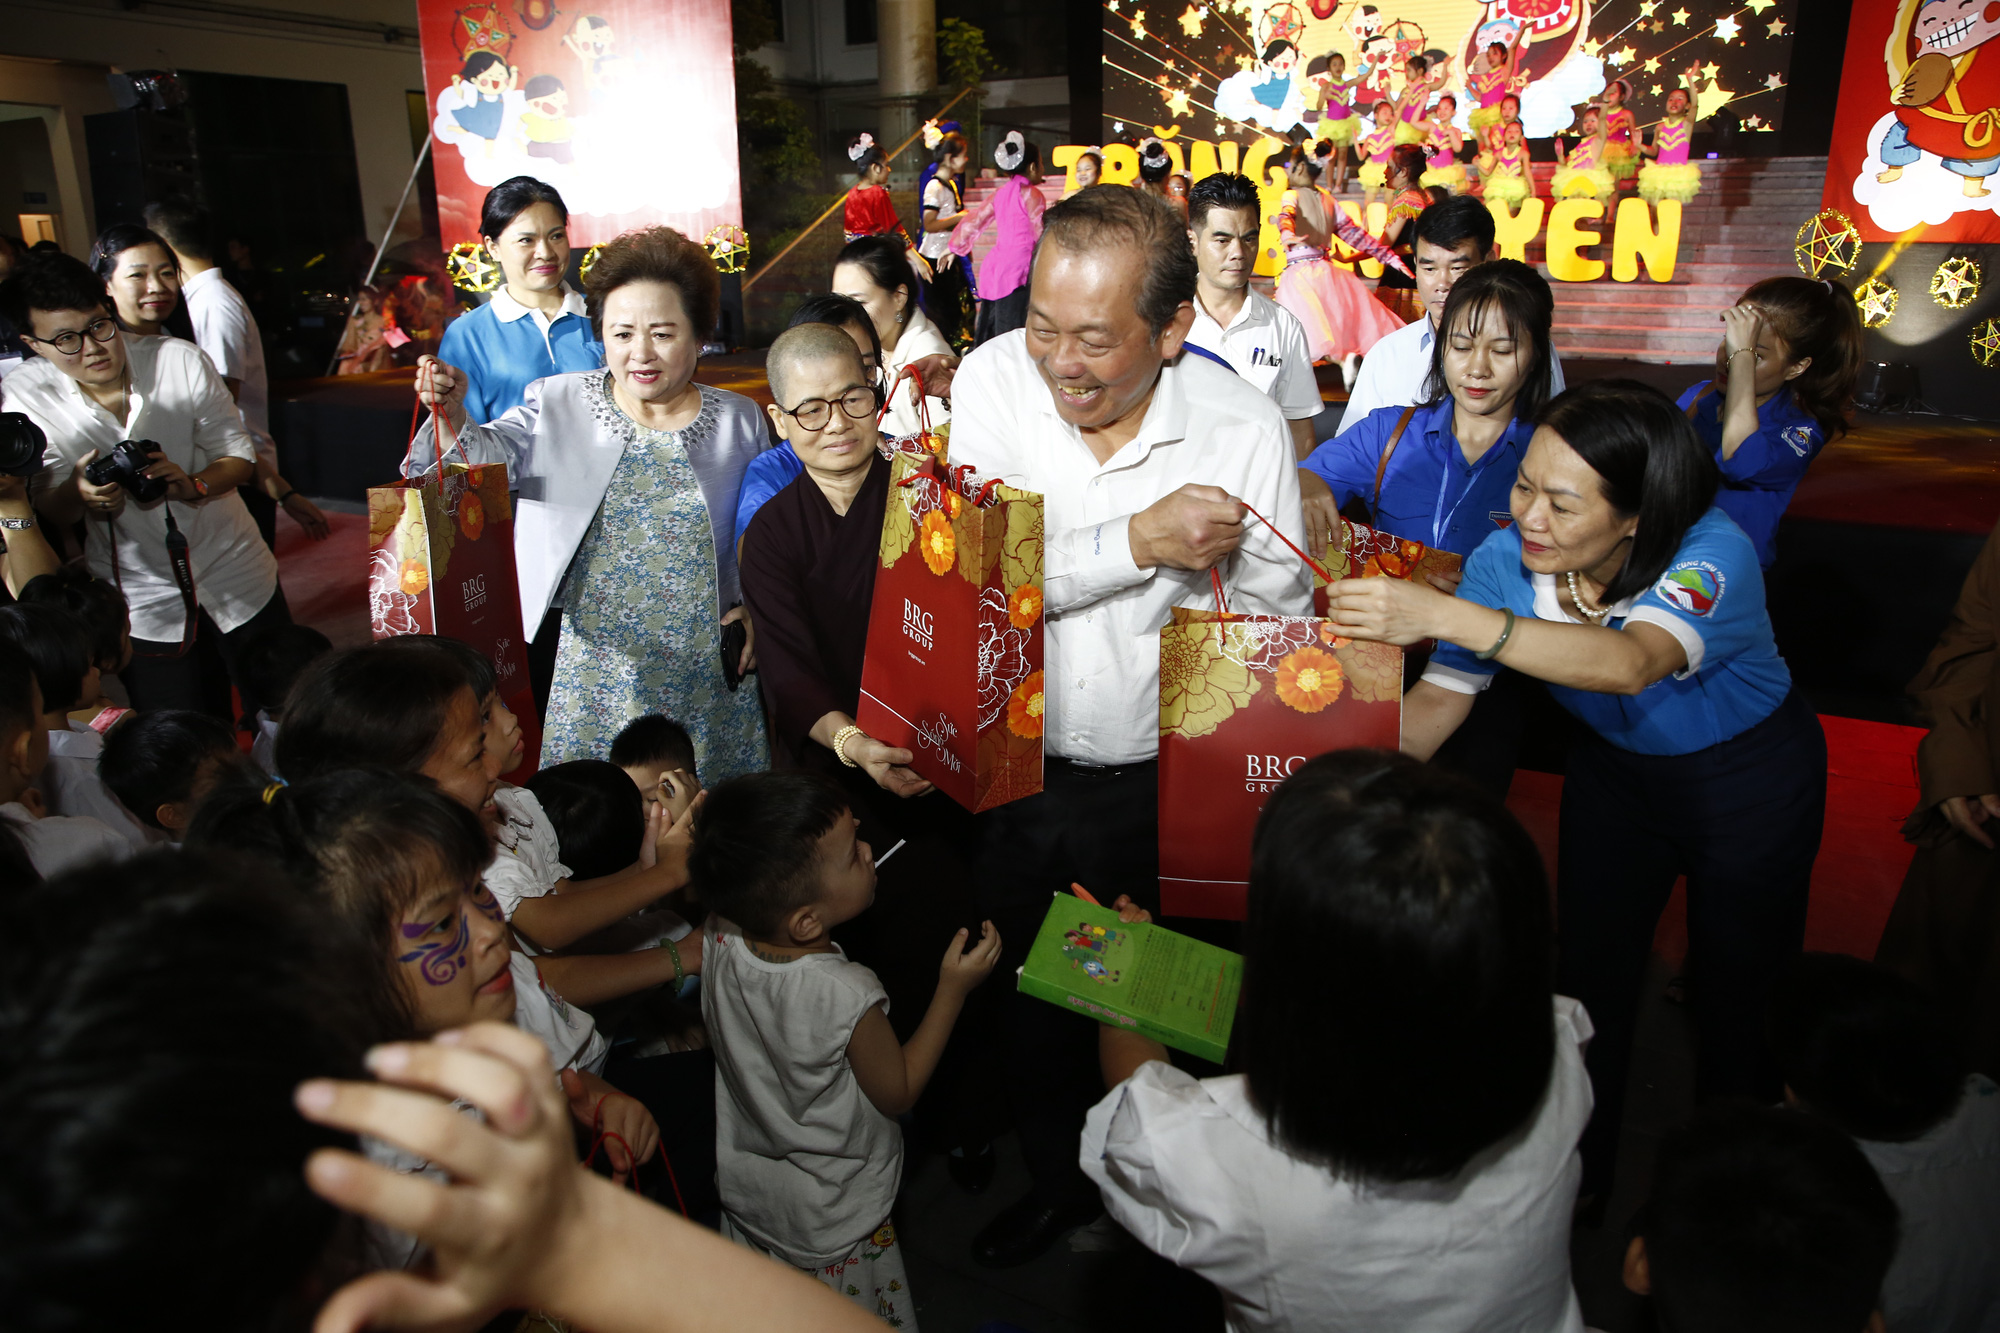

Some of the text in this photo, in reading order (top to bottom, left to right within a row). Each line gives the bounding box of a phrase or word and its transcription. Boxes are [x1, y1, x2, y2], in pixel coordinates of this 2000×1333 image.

[1486, 175, 1681, 283] YÊN
[462, 574, 486, 600] BRG
[464, 595, 487, 612] GROUP
[904, 597, 934, 636] BRG
[902, 624, 933, 652] GROUP
